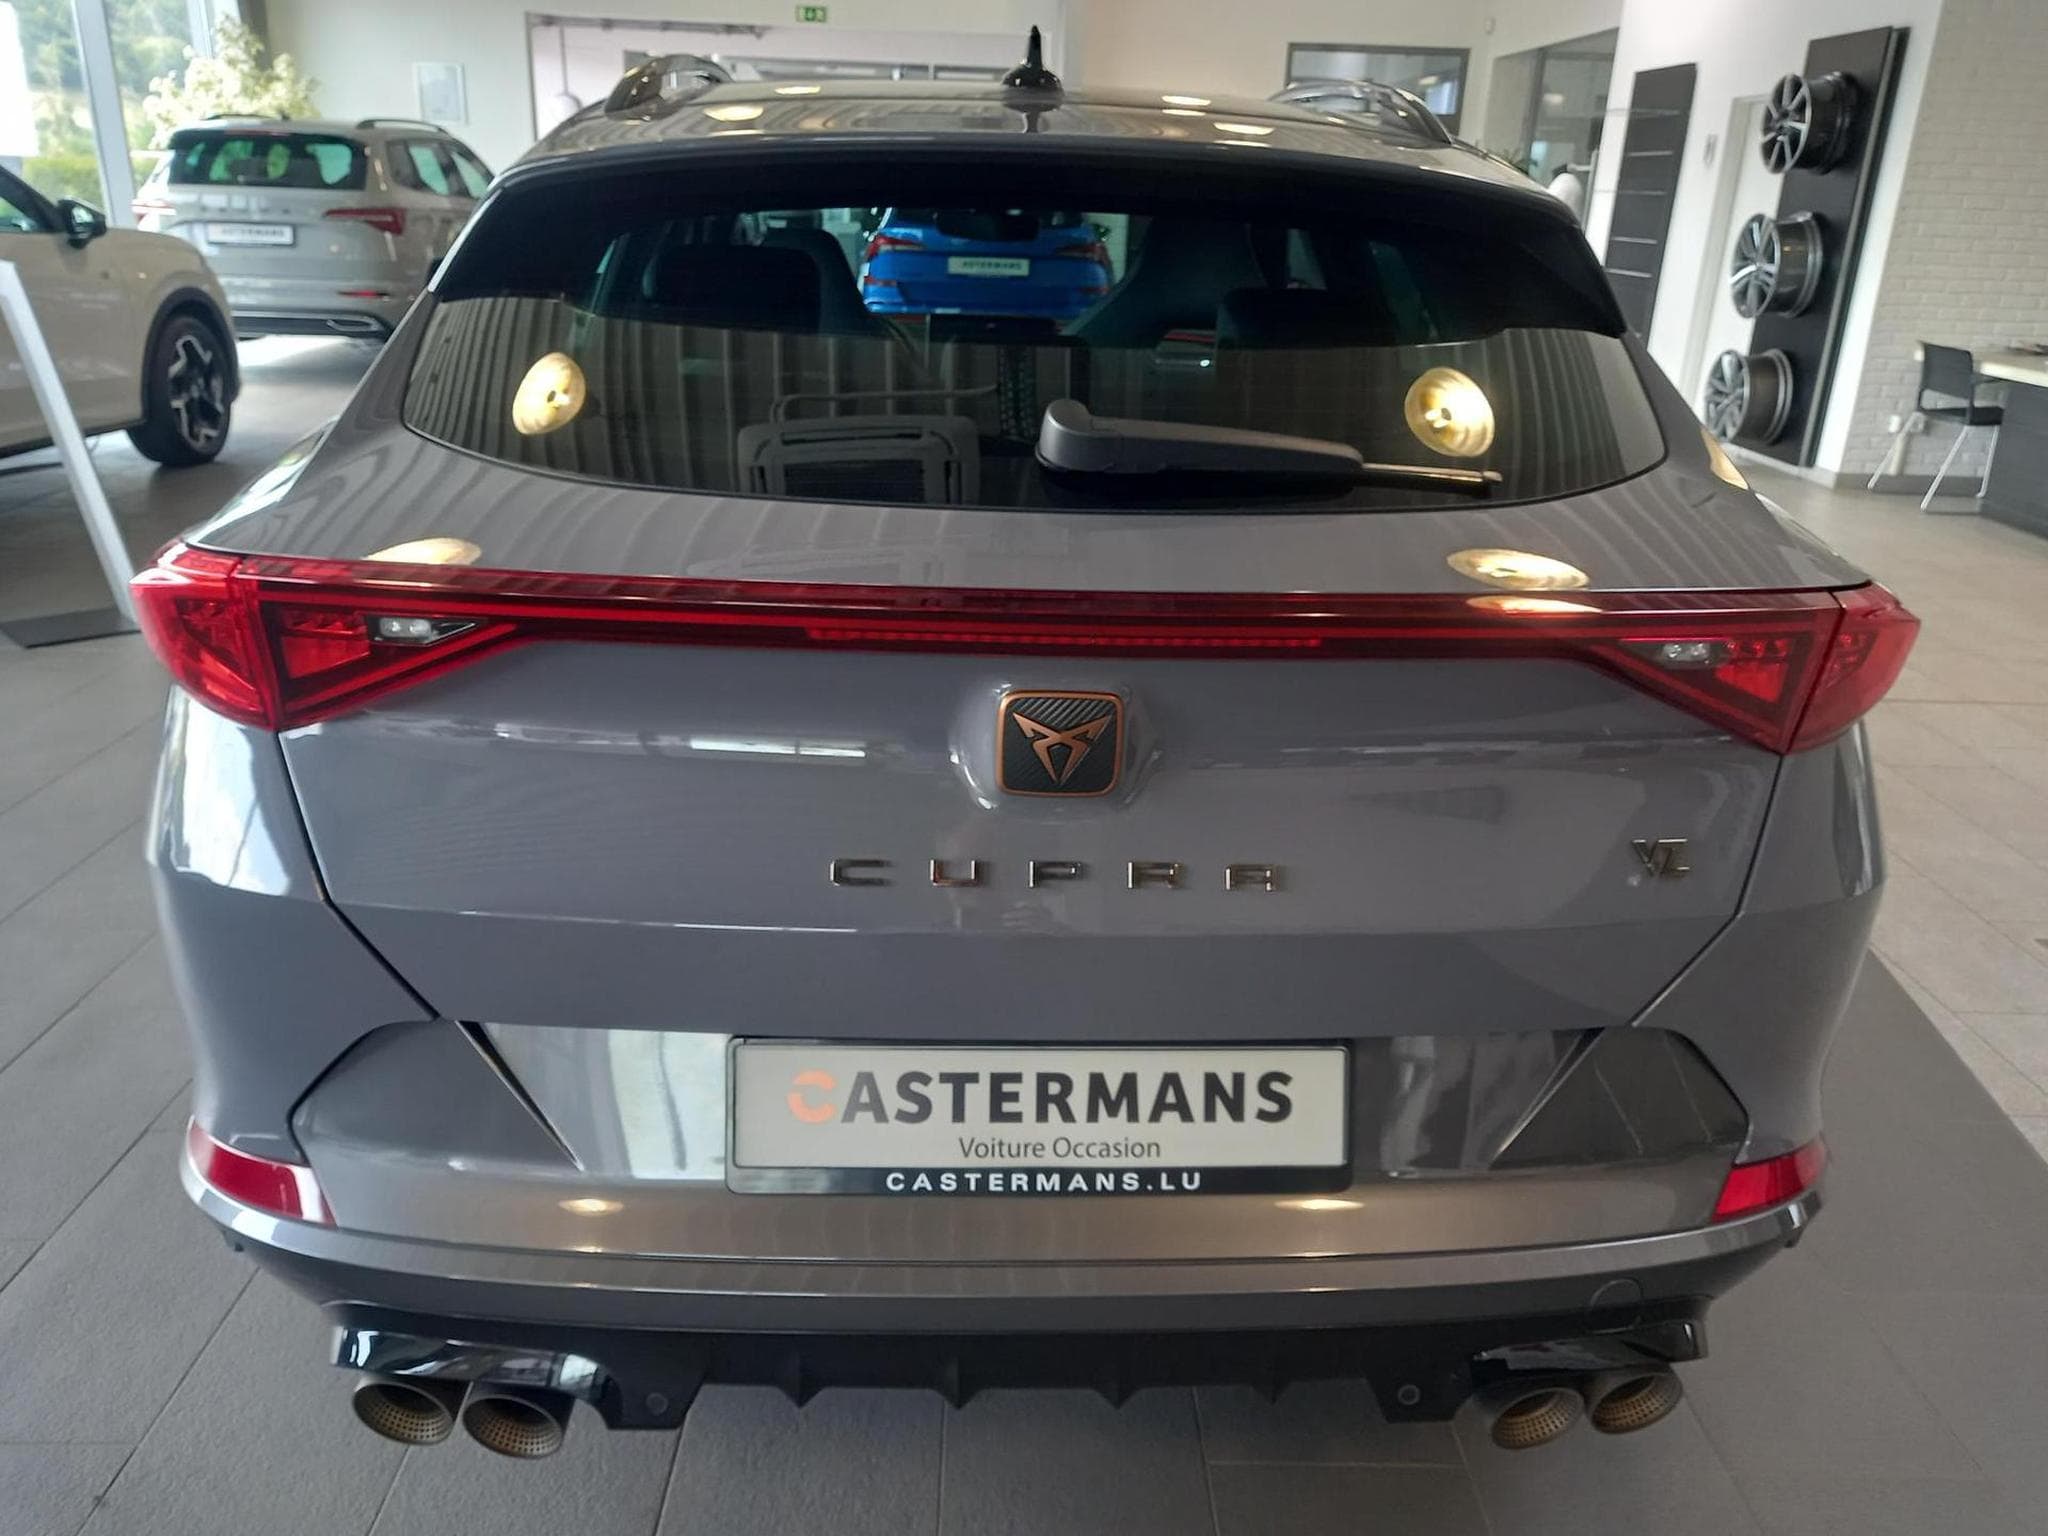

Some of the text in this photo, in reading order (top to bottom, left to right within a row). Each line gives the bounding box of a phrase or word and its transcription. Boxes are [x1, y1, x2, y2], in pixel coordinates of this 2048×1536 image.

[830, 858, 1281, 893] CUPRA
[788, 1069, 1293, 1124] CASTERMANS
[958, 1136, 1161, 1159] Voiture Occasion
[885, 1171, 1201, 1192] CASTERMANS.LU
